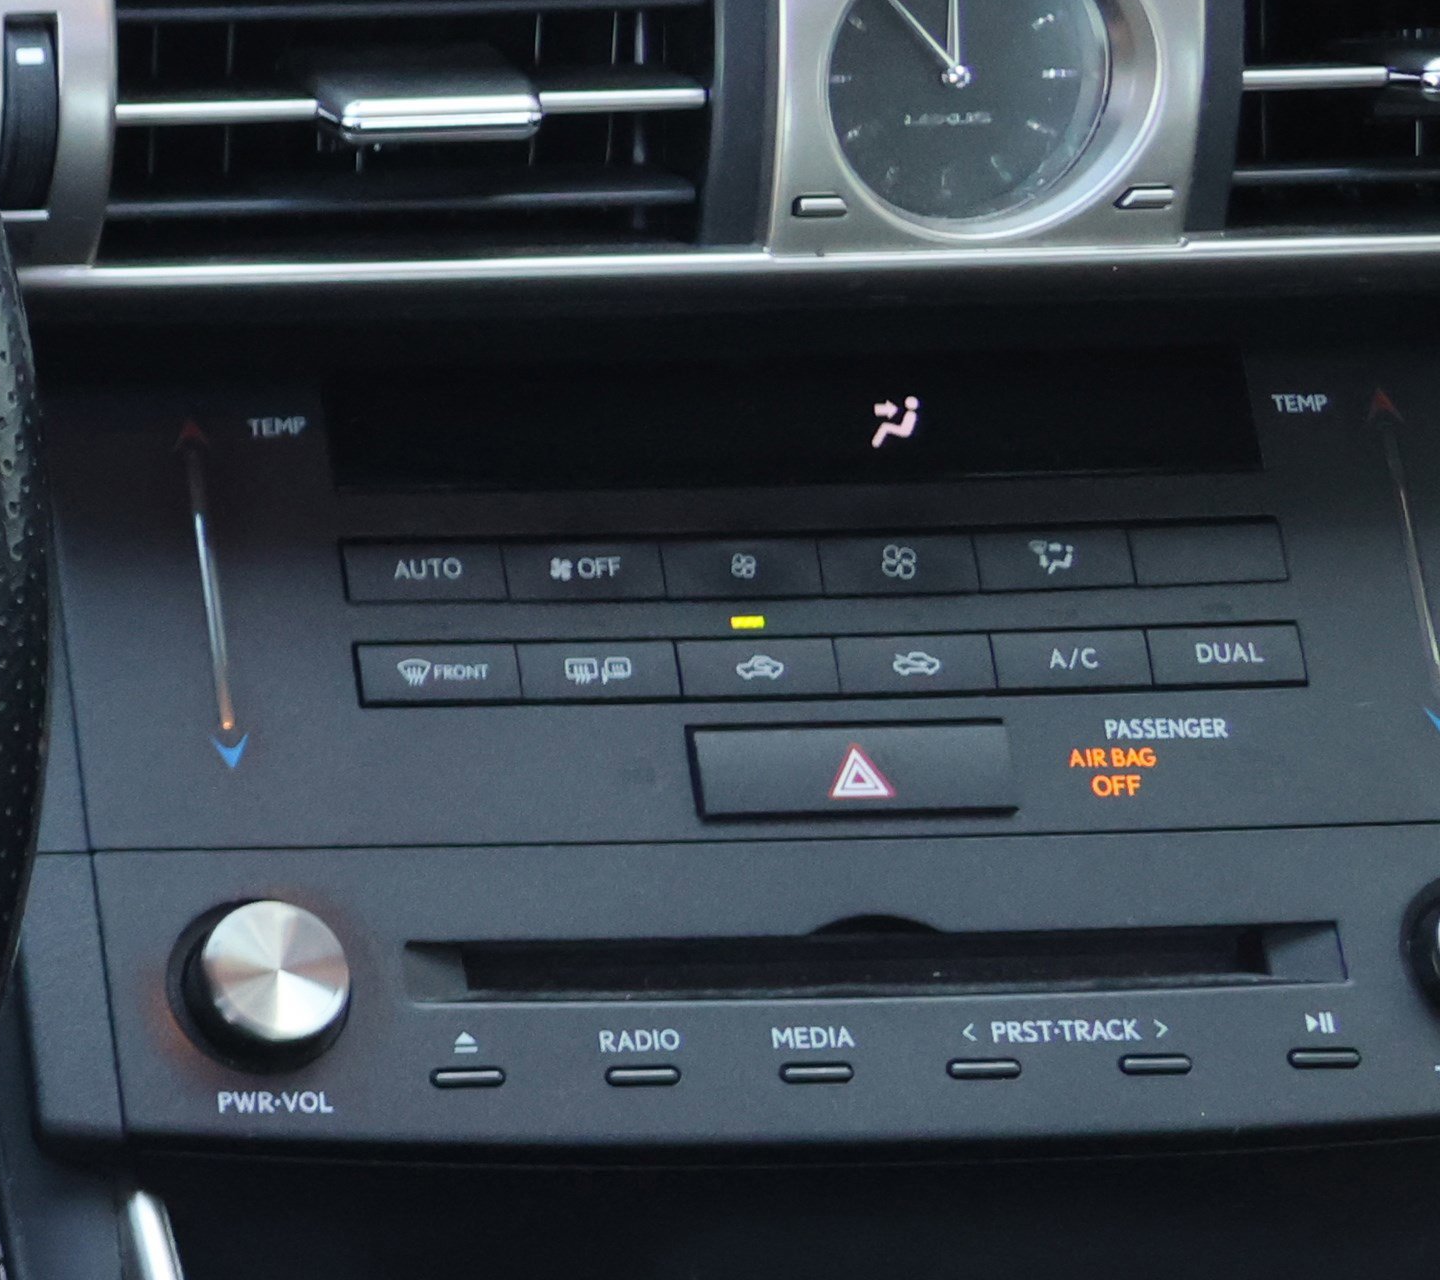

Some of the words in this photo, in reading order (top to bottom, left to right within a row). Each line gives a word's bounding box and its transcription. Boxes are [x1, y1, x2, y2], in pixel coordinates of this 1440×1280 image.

[1271, 393, 1328, 414] TEMP
[247, 417, 307, 438] TEMP
[393, 557, 463, 581] AUTO
[577, 556, 622, 580] OFF
[1049, 647, 1100, 671] A/C
[1195, 641, 1265, 664] DUAL
[433, 662, 489, 682] FRONT
[1104, 718, 1230, 741] PASSENGER
[1069, 748, 1107, 769] AIR
[1111, 747, 1158, 768] BAG
[1091, 775, 1142, 798] OFF
[598, 1028, 681, 1053] RADIO
[771, 1026, 855, 1050] MEDIA
